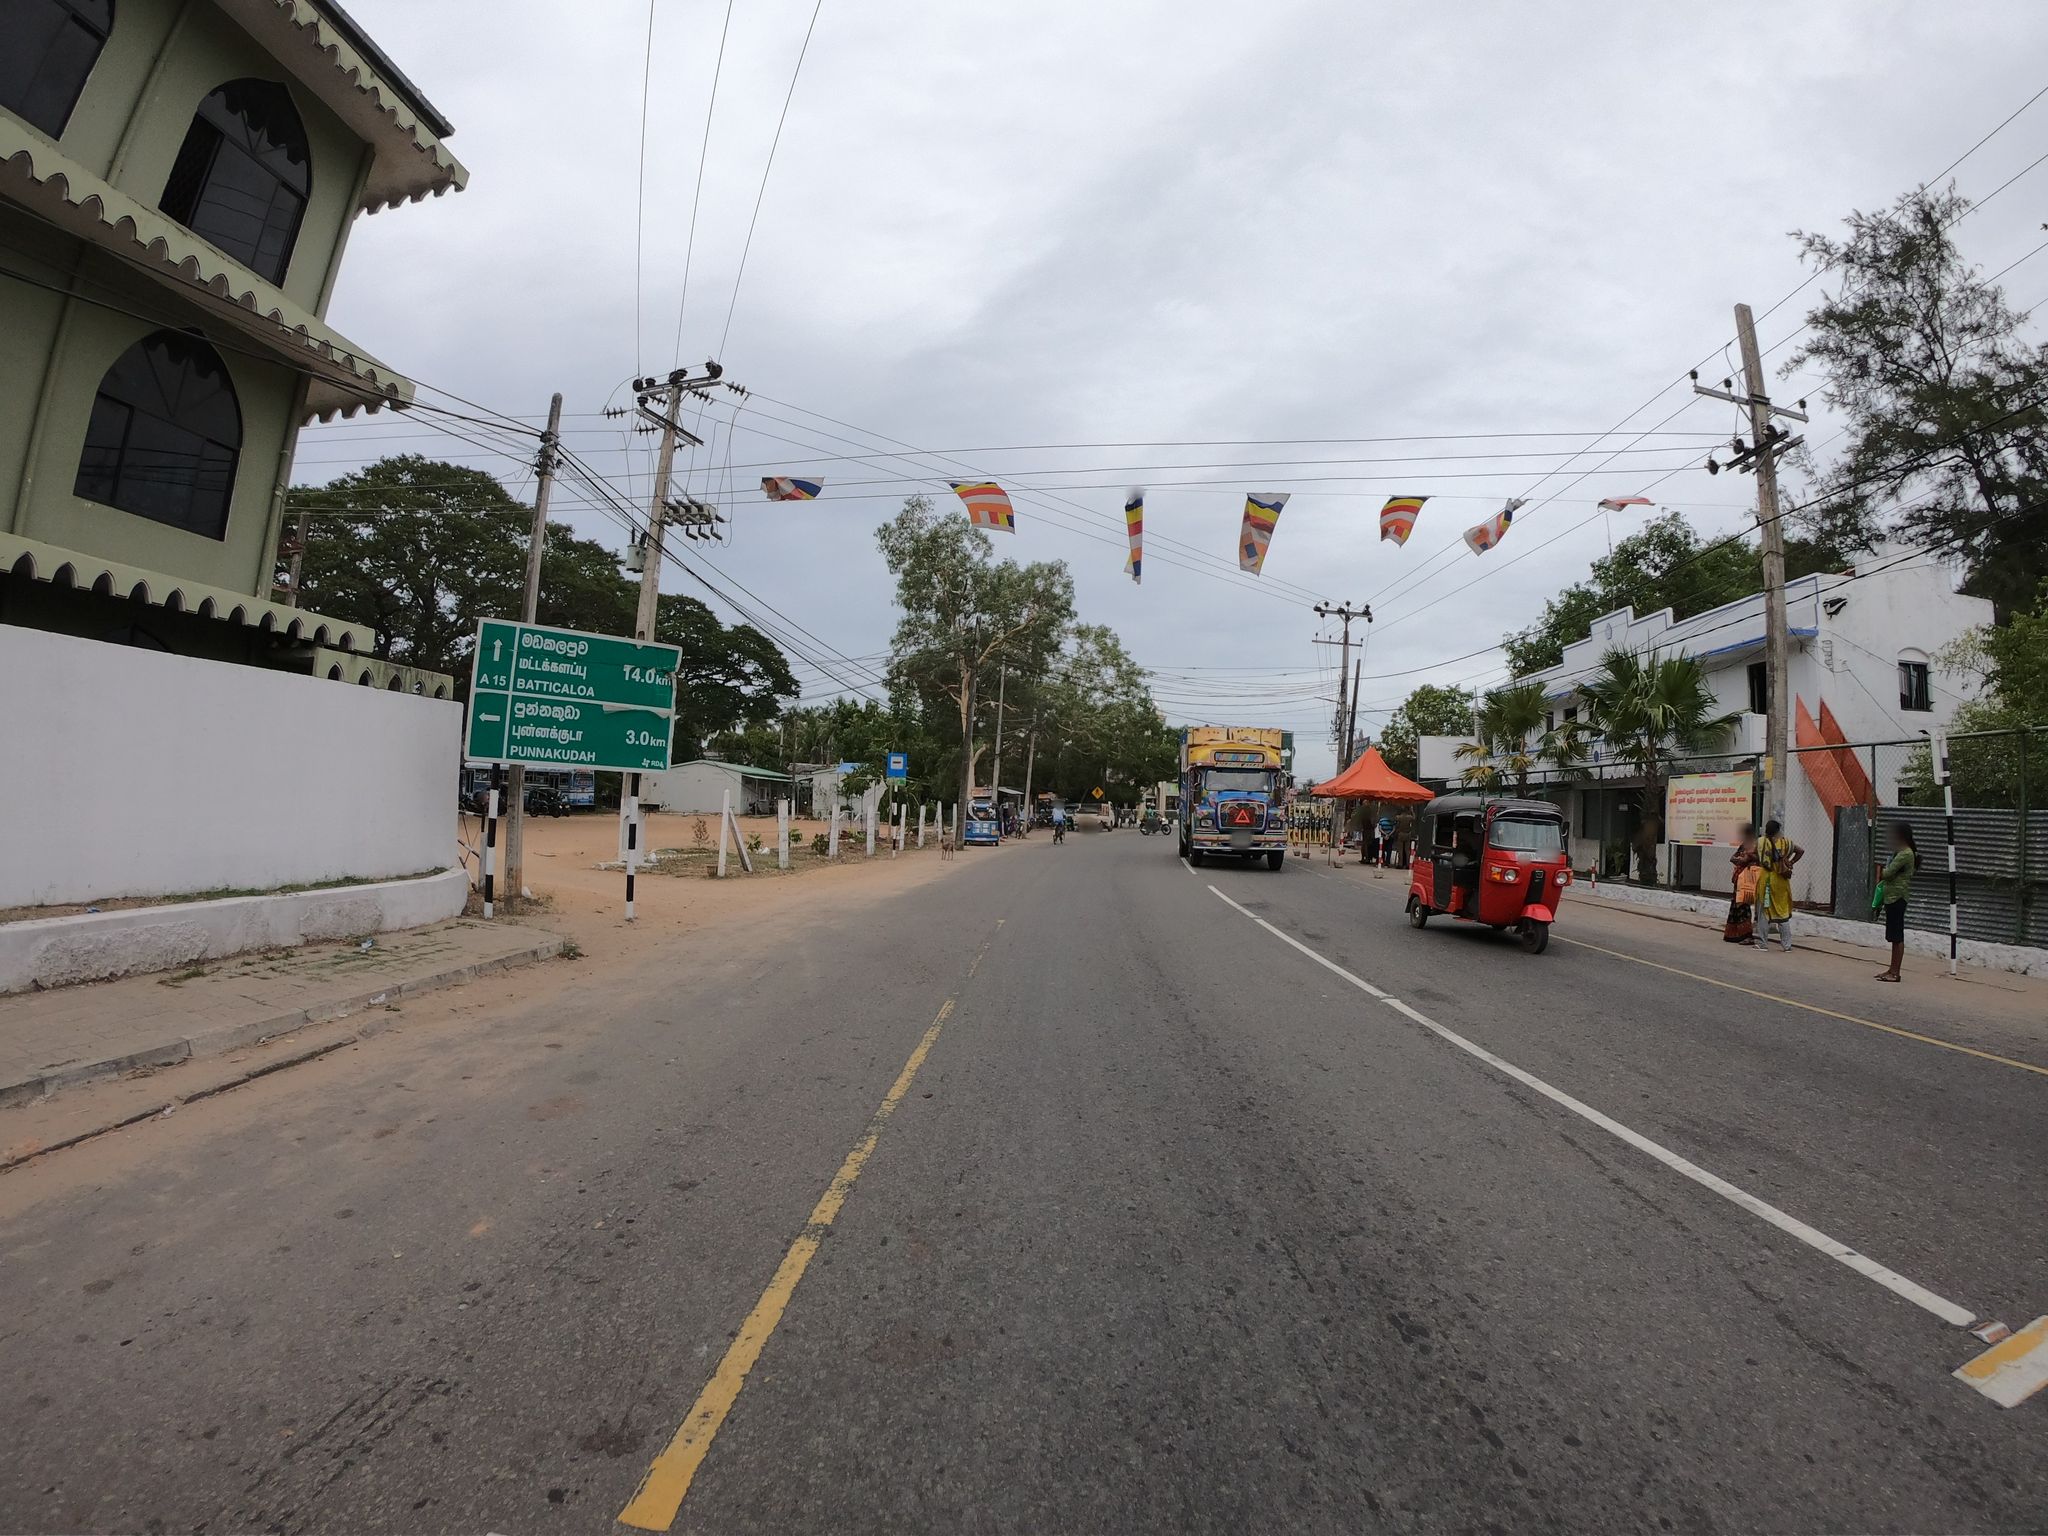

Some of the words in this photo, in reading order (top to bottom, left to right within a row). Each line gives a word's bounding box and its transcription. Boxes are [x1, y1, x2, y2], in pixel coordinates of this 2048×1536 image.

[521, 633, 589, 657] මඩකලපුව
[519, 656, 587, 680] மட்டக்களப்பு
[479, 673, 489, 684] A
[492, 674, 506, 686] 15
[516, 678, 595, 697] BATTICALOA
[511, 723, 583, 744] புன்னக்குடா
[509, 745, 596, 762] PUNNAKUDAH
